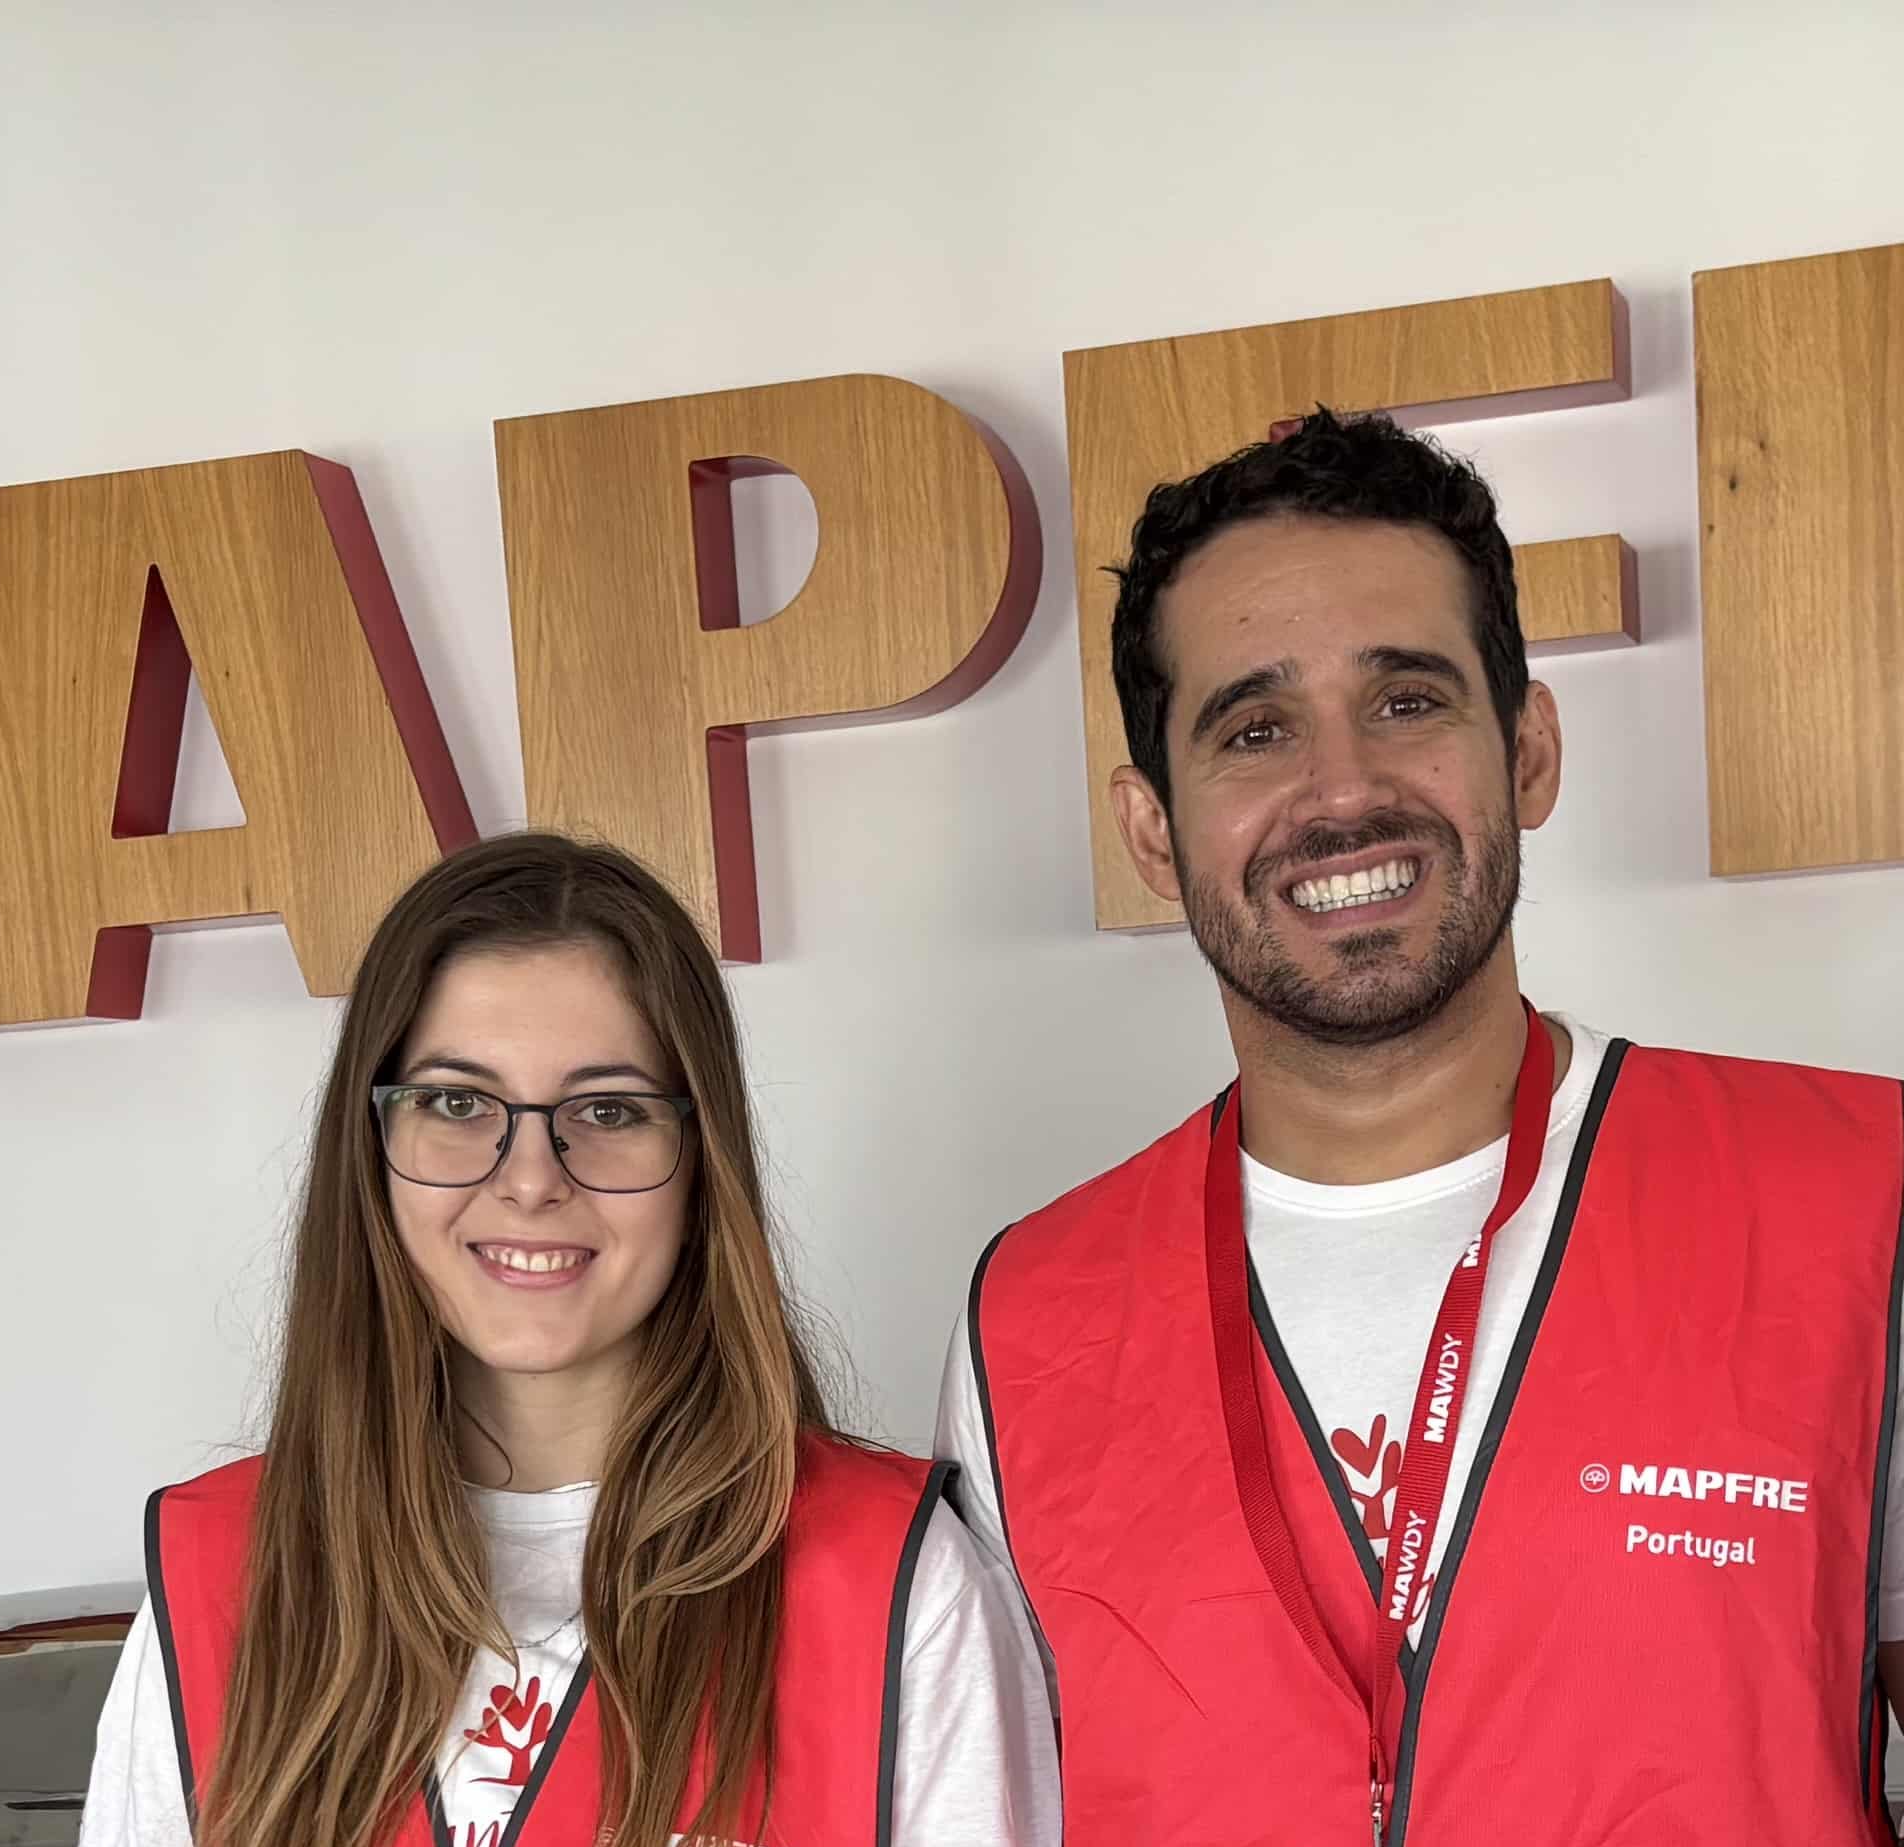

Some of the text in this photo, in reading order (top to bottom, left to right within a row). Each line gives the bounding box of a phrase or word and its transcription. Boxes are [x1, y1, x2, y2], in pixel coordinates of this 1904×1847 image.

[1423, 1334, 1464, 1444] MAWDY
[1619, 1463, 1808, 1513] MAPFRE
[1389, 1510, 1427, 1621] MAWDY
[1625, 1524, 1756, 1568] Portugal
